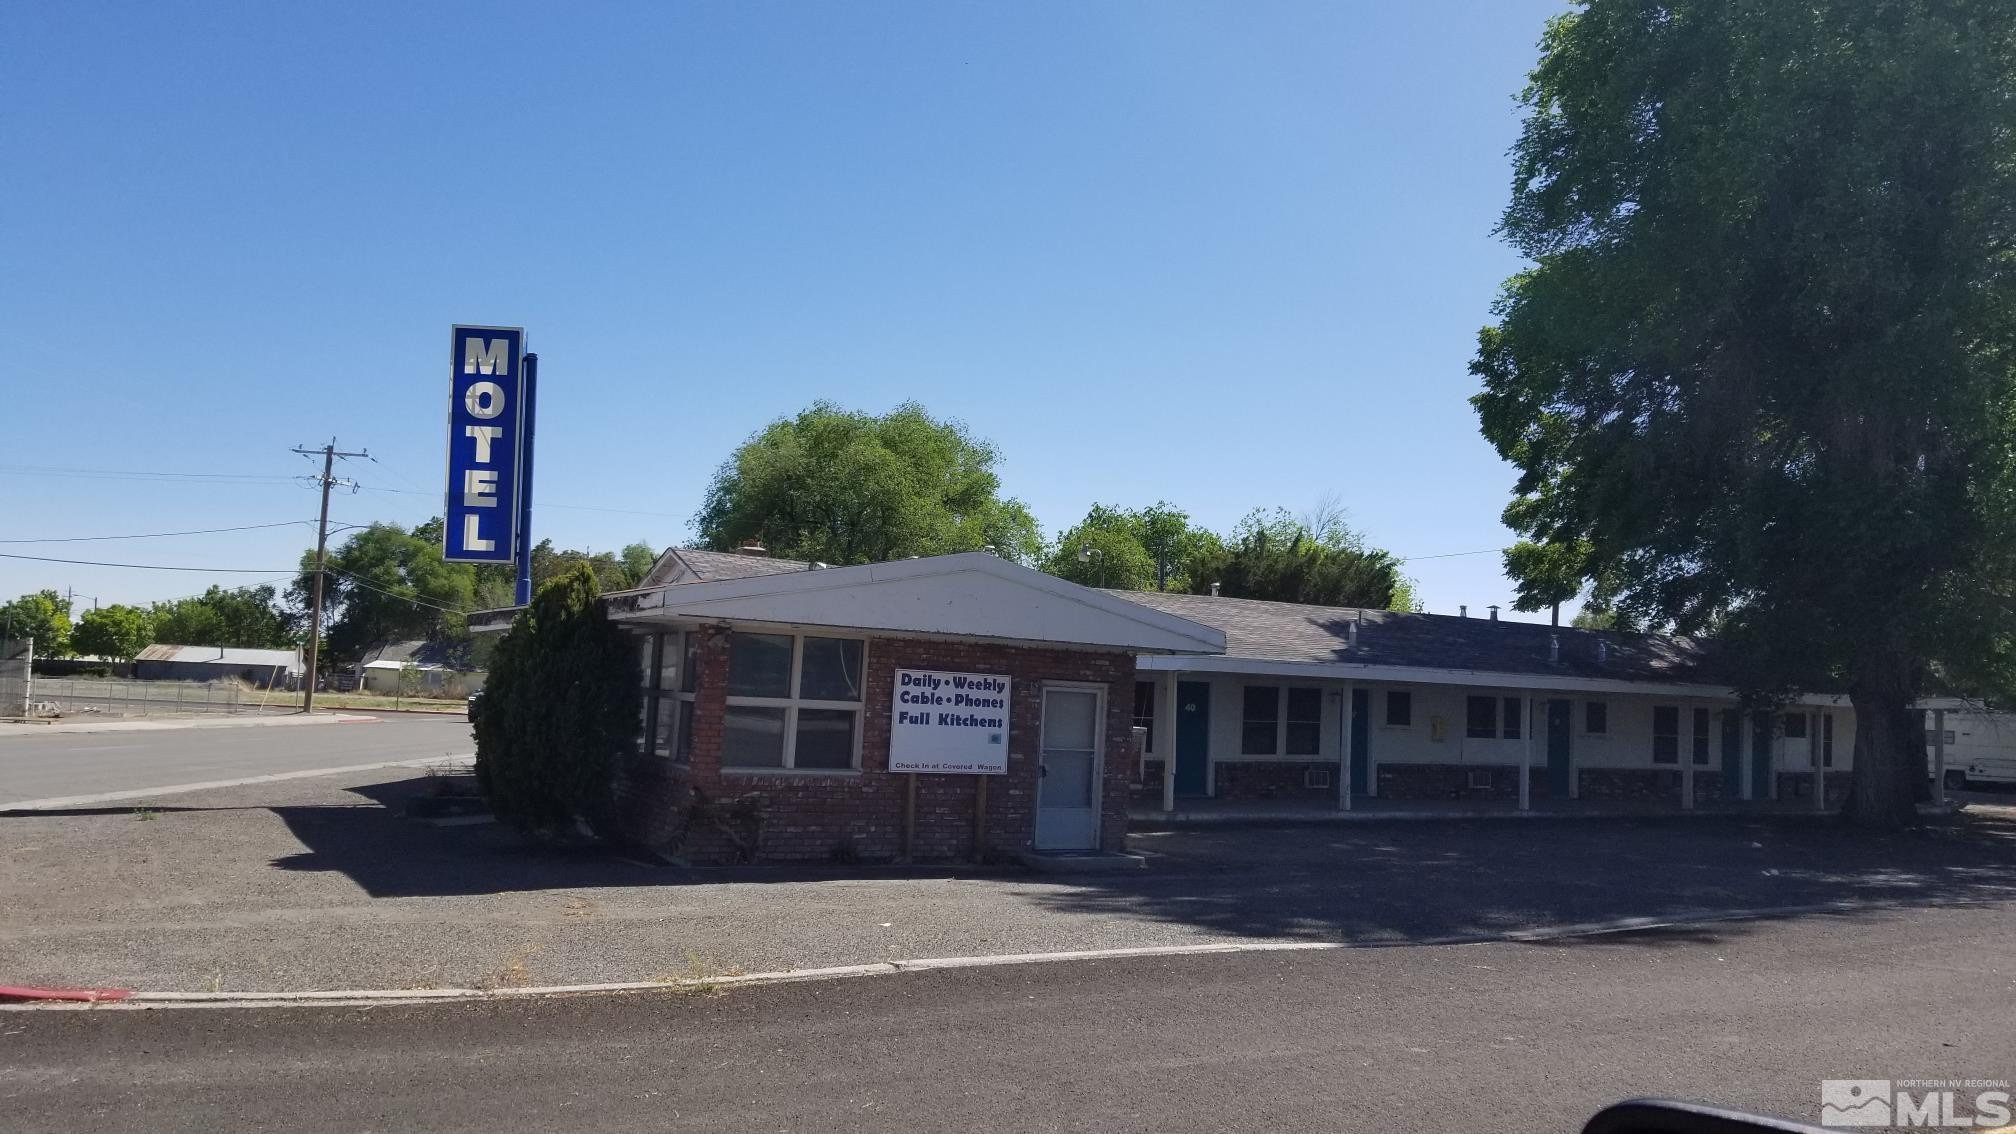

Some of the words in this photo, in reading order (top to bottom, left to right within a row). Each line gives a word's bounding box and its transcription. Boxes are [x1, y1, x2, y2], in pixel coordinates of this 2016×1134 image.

[463, 337, 509, 552] MOTEL
[900, 673, 941, 690] Daily
[953, 676, 1005, 694] Weekly
[900, 691, 943, 705] Cable
[954, 693, 1004, 709] Phones
[1184, 703, 1196, 713] 40
[898, 711, 930, 725] Full
[938, 712, 1003, 728] Kitchens
